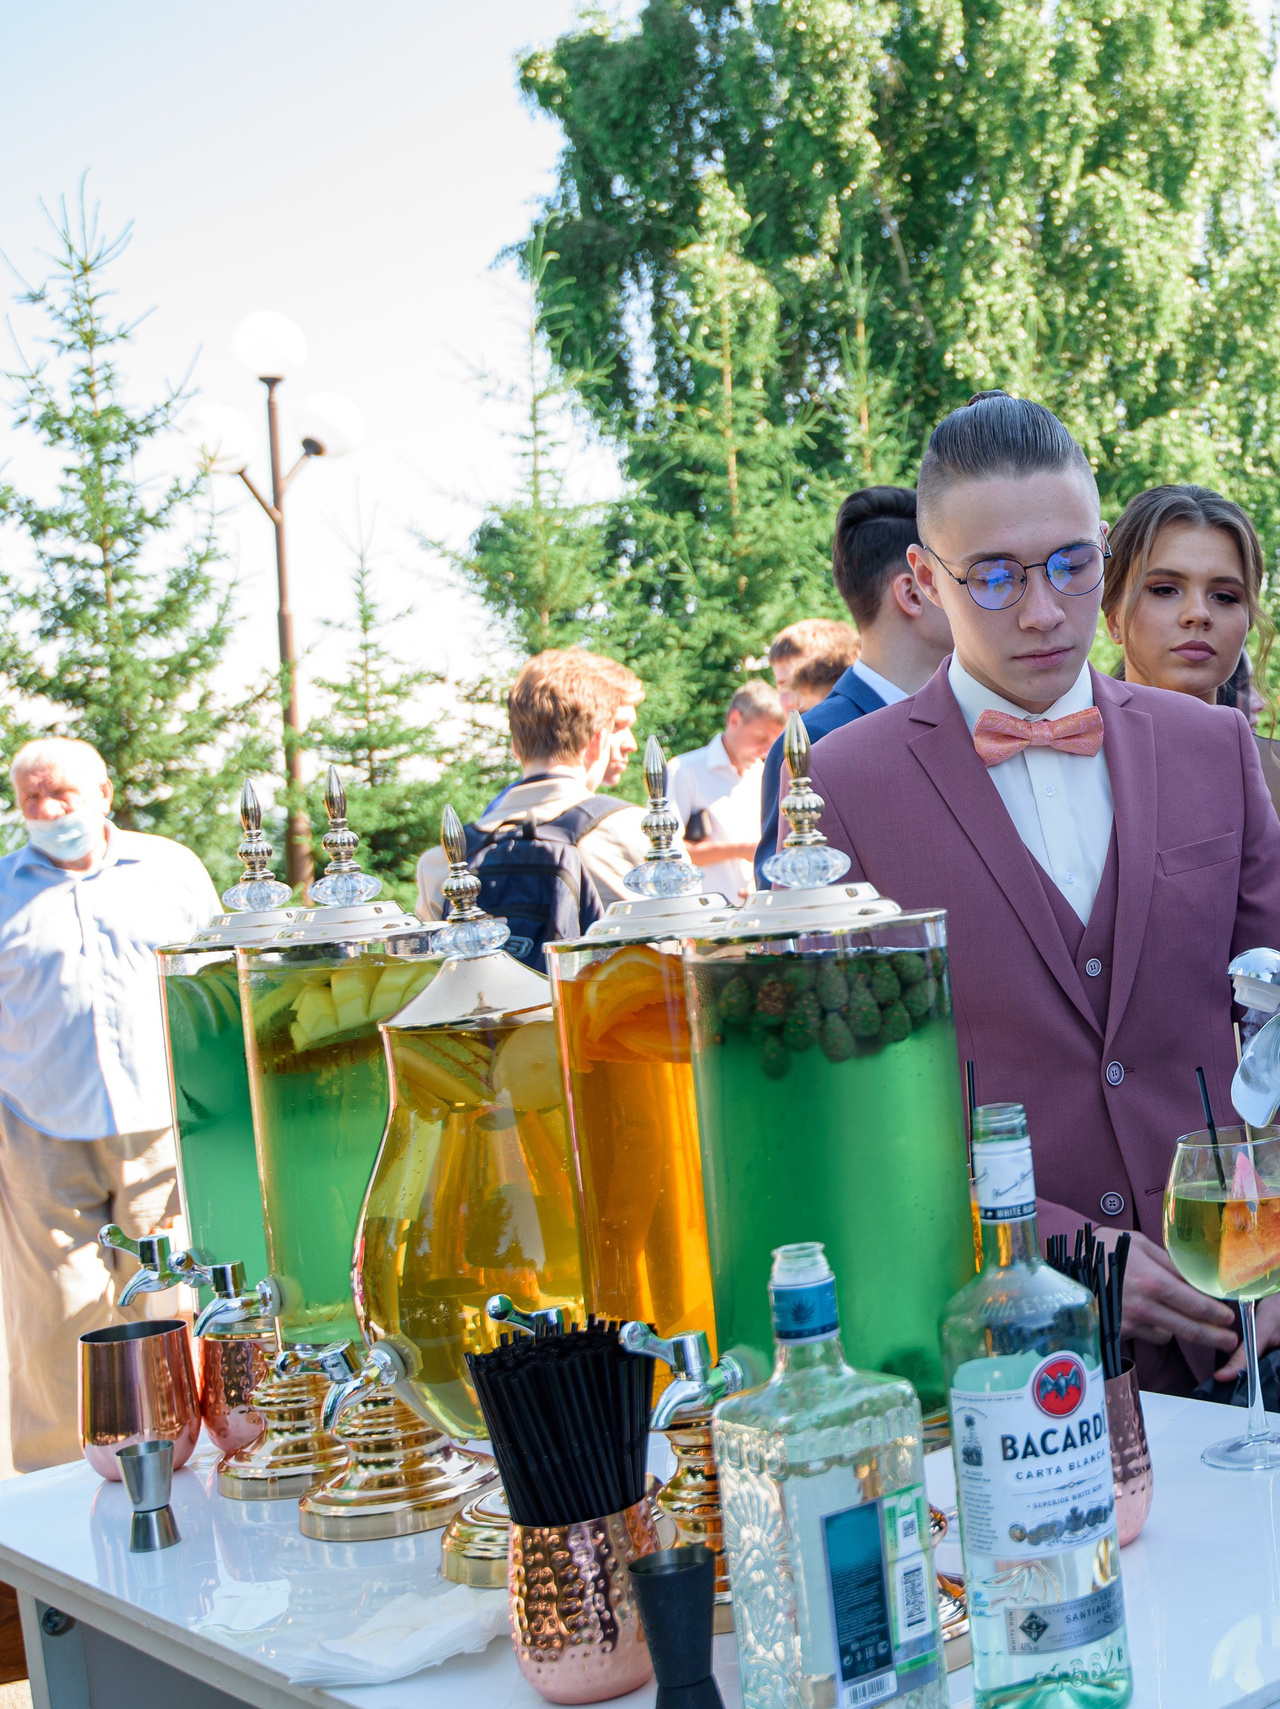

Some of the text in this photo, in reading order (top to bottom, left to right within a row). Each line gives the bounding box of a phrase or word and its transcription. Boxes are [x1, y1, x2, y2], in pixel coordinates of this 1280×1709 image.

[996, 1206, 1022, 1219] WHITE
[1015, 1449, 1106, 1480] CARTA BLANCA
[1033, 1496, 1070, 1509] SUPERIOR
[1071, 1488, 1091, 1500] WHITE
[1065, 1599, 1112, 1623] SANTIAGO
